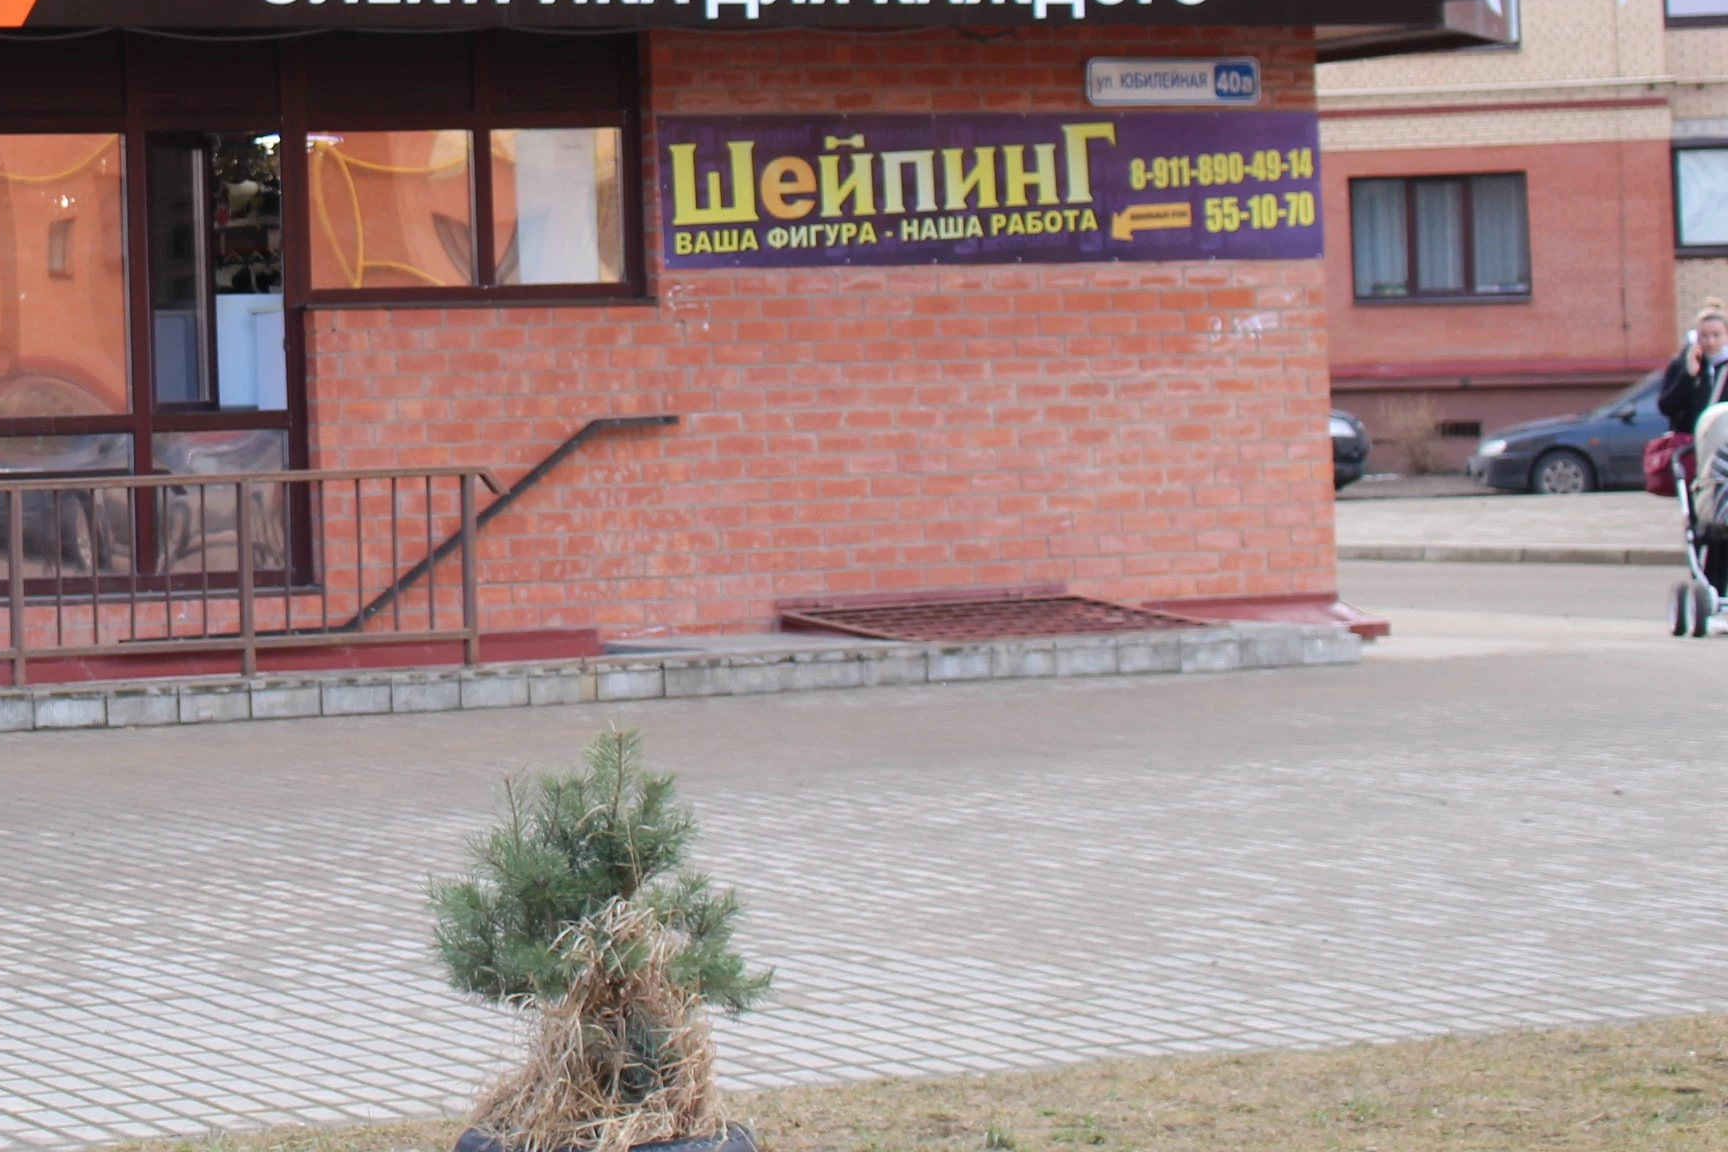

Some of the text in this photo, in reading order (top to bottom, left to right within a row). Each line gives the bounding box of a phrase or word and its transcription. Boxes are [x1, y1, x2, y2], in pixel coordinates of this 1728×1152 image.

[1120, 68, 1208, 90] ЮБИЛЕЙНАЯ
[1129, 148, 1314, 190] 8-911-890-49-14
[674, 228, 760, 256] ВАША
[766, 221, 878, 250] ФИГУРА
[901, 215, 984, 242] НАША
[990, 209, 1099, 235] РАБОТА
[1205, 191, 1315, 233] 55-10-70
